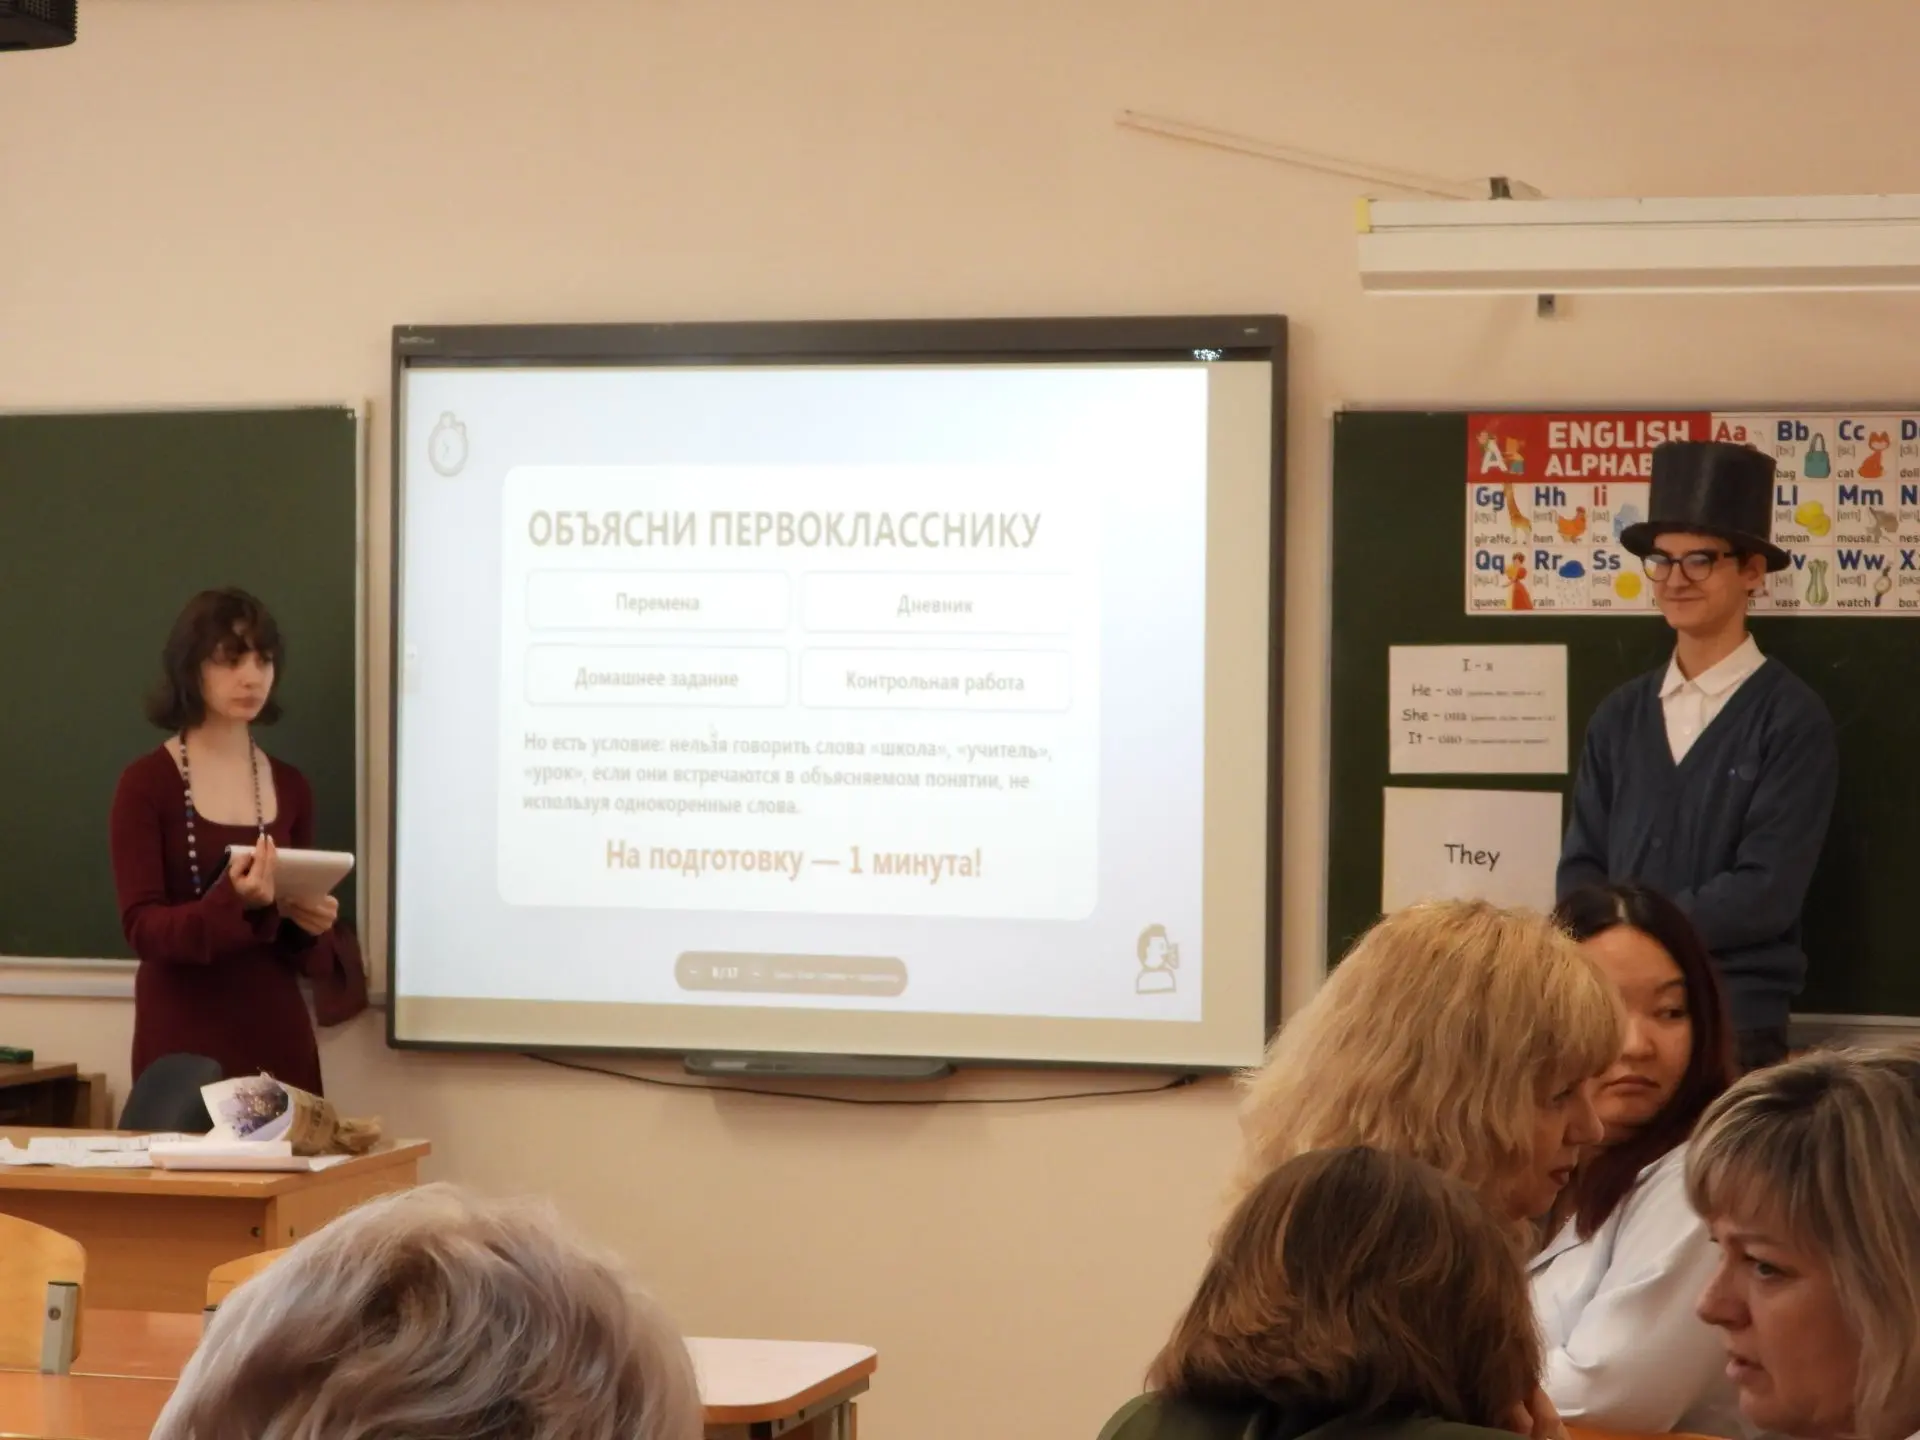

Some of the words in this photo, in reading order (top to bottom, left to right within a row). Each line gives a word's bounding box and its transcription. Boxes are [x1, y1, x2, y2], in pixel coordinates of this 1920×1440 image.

[1548, 420, 1690, 448] ENGLISH
[1715, 421, 1747, 442] Aa
[1777, 420, 1810, 441] Bb
[1839, 420, 1865, 441] Cc
[1901, 420, 1920, 441] D
[1544, 453, 1652, 477] ALPHAB
[1776, 469, 1796, 480] bag
[1837, 468, 1854, 478] cat
[1900, 468, 1920, 478] doll
[1475, 486, 1505, 511] Gg
[1535, 486, 1566, 506] Hh
[1593, 485, 1608, 506] Ii
[1777, 485, 1798, 506] Ll
[1838, 485, 1884, 506] Mm
[528, 510, 697, 547] ОБЪЯСНИ
[709, 511, 1041, 548] ПЕРВОКЛАССНИКУ
[1533, 534, 1553, 544] hen
[1592, 534, 1607, 544] ice
[1776, 533, 1810, 543] lemon
[1837, 534, 1872, 543] mouse
[1900, 534, 1920, 543] nes
[1474, 533, 1511, 547] giraffe
[1475, 549, 1505, 574] Qq
[1535, 549, 1563, 570] Rr
[1592, 549, 1621, 570] Ss
[1837, 549, 1885, 570] Ww
[1900, 549, 1920, 570] X
[616, 592, 700, 615] Перемена
[897, 594, 973, 617] Дневник
[1474, 599, 1506, 609] queen
[1533, 597, 1555, 607] rain
[1592, 598, 1611, 608] sun
[1776, 599, 1800, 608] vase
[1837, 597, 1871, 608] watch
[1899, 598, 1918, 608] box
[1462, 658, 1471, 672] I
[575, 667, 665, 690] Домашнее
[670, 670, 739, 690] задание
[846, 670, 959, 693] Контрольная
[964, 671, 1024, 695] работа
[1412, 683, 1432, 697] He
[1402, 708, 1429, 722] She
[524, 732, 547, 750] Но
[552, 736, 587, 751] есть
[592, 736, 663, 757] условие:
[669, 738, 727, 754] нельзя
[733, 739, 810, 759] говорить
[815, 740, 865, 756] слова
[871, 741, 951, 759] «школа»,
[957, 742, 1052, 762] «учитель»,
[1408, 731, 1422, 744] It
[524, 765, 587, 785] «урок»,
[592, 767, 631, 782] если
[636, 767, 667, 782] они
[673, 767, 780, 787] встречаются
[785, 770, 794, 783] в
[800, 765, 920, 787] объясняемом
[925, 771, 1003, 790] понятии,
[1009, 772, 1030, 789] не
[523, 795, 610, 816] используя
[614, 796, 742, 818] однокоренные
[747, 798, 801, 814] слова.
[606, 839, 641, 869] На
[650, 846, 803, 882] подготовку
[849, 845, 863, 874] 1
[873, 847, 982, 885] минута!
[1444, 843, 1500, 872] They
